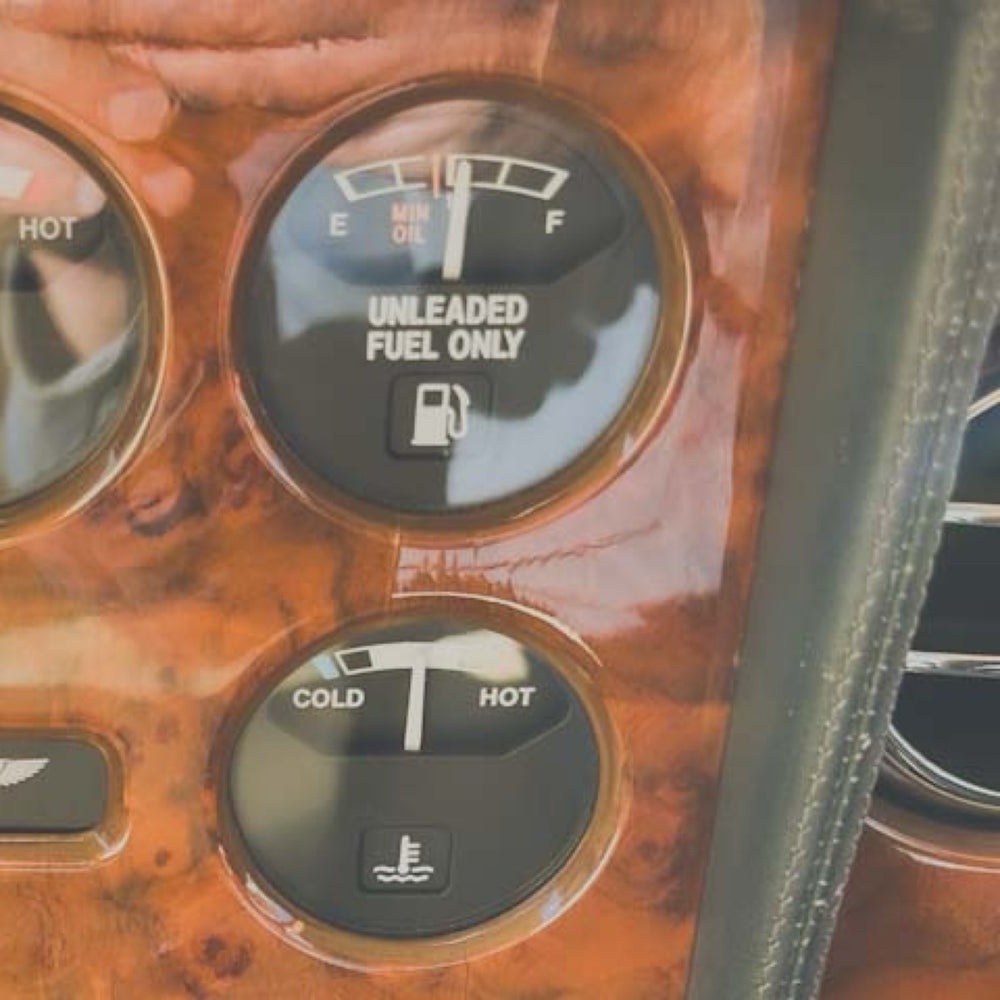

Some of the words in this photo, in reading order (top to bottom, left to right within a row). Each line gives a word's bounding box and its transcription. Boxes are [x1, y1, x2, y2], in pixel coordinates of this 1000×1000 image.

[329, 212, 349, 236] E
[390, 203, 430, 223] MIN
[545, 210, 566, 234] F
[18, 216, 79, 241] HOT
[391, 224, 428, 244] OIL
[367, 294, 529, 326] UNLEADED
[365, 330, 439, 361] FUEL
[447, 328, 526, 360] ONLY
[292, 687, 366, 709] COLD
[478, 686, 537, 707] HOT
